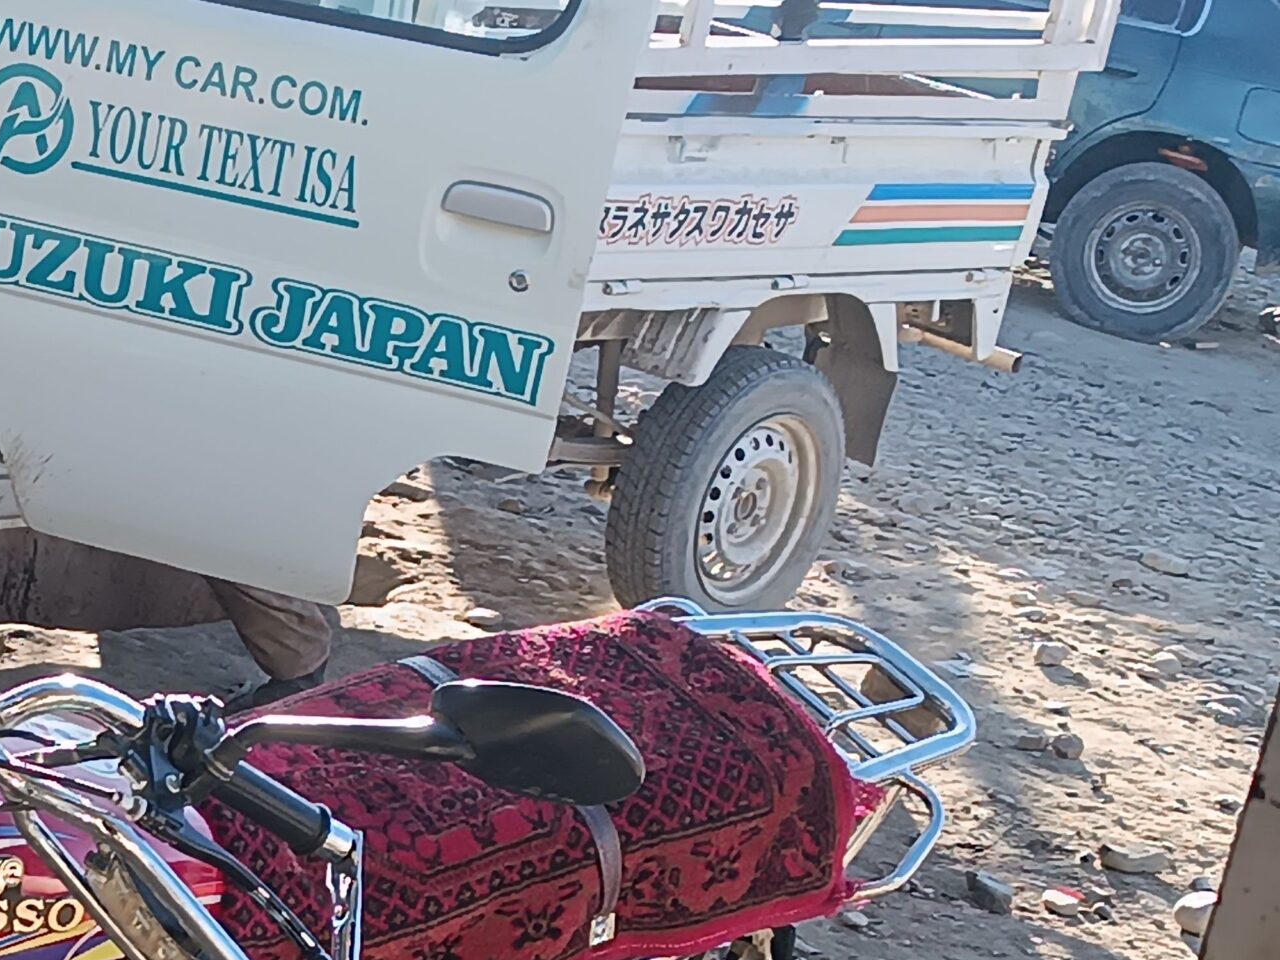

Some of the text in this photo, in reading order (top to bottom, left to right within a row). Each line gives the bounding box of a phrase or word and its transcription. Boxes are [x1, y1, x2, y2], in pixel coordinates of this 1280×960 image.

[88, 99, 188, 177] YOUR
[196, 123, 295, 199] TEXT
[251, 277, 555, 406] JAPAN
